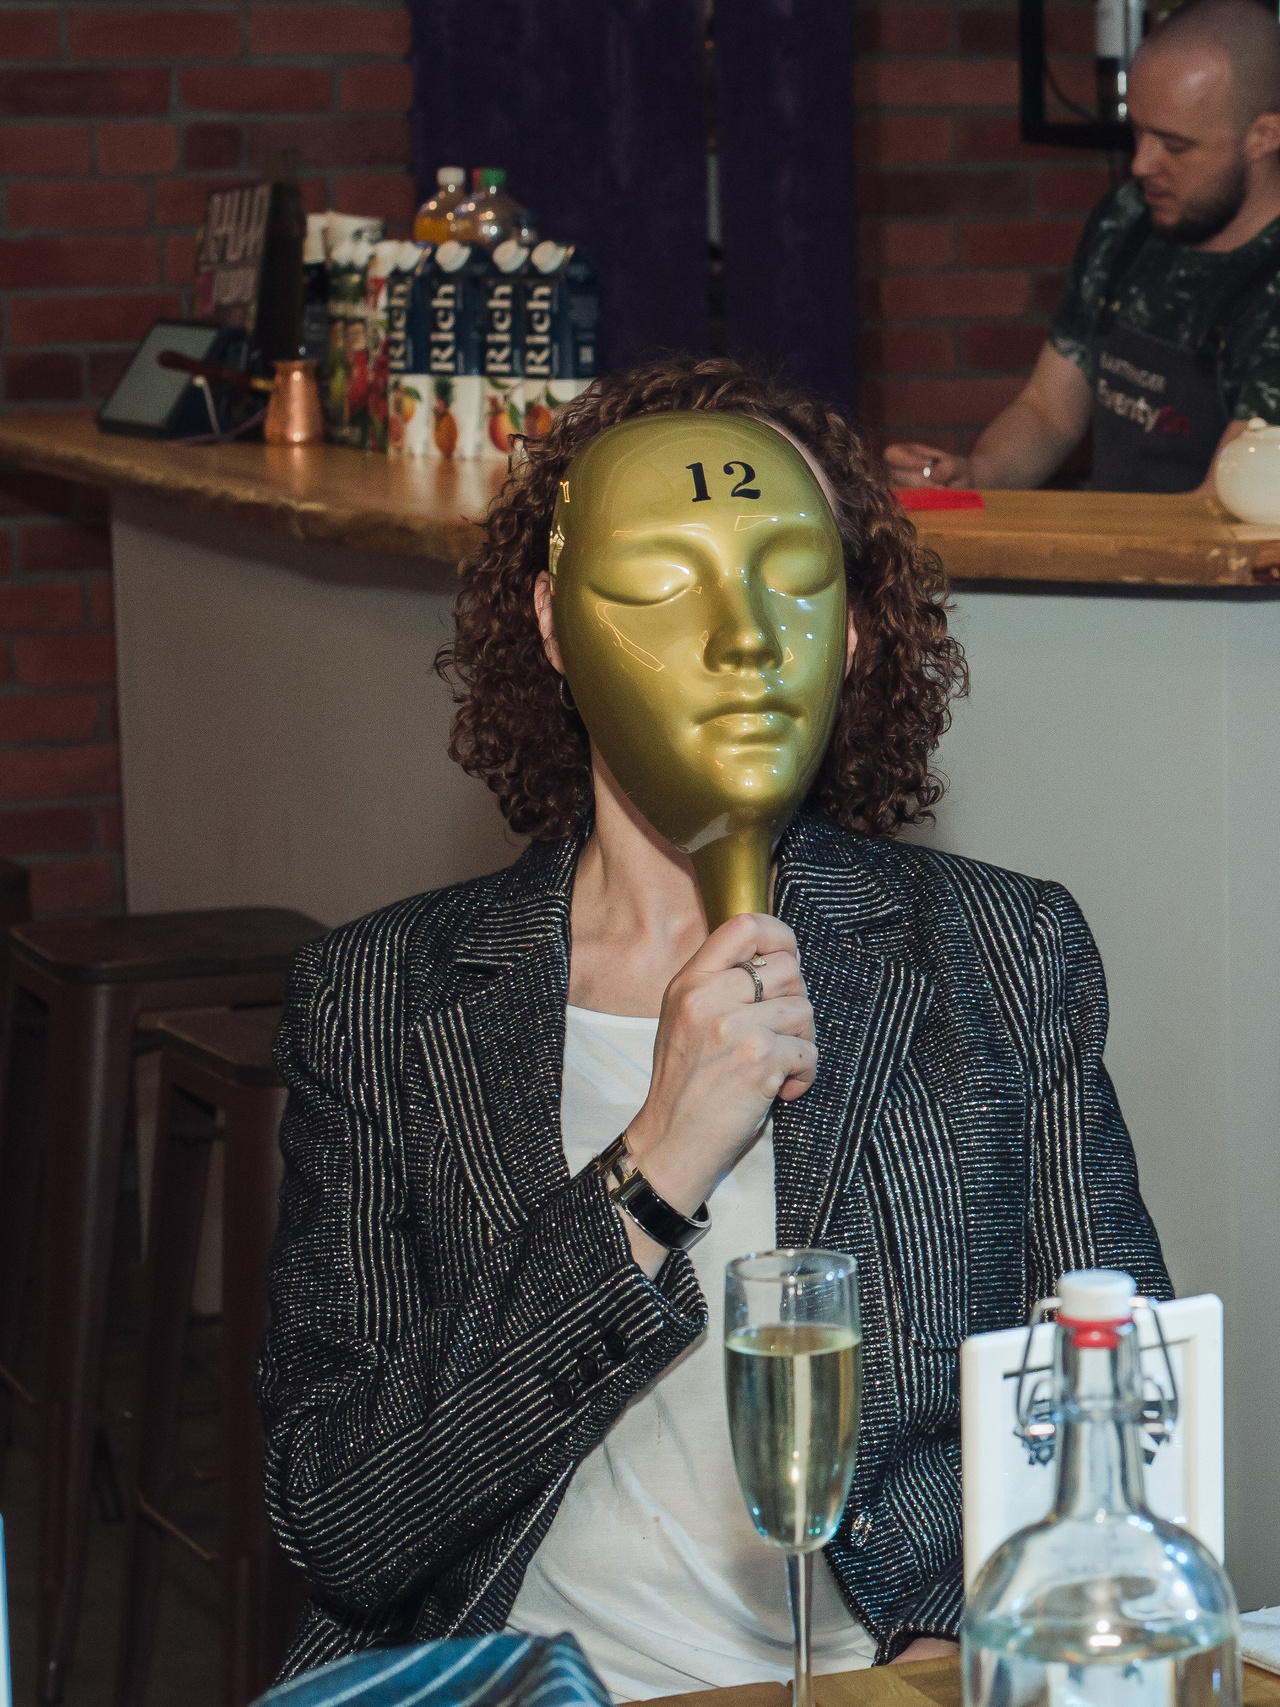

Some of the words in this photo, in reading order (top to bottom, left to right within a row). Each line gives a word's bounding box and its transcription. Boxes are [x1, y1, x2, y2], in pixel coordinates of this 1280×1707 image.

[430, 284, 456, 372] Rich
[485, 285, 513, 373] Rich
[525, 285, 552, 375] Rich
[685, 461, 761, 502] 12
